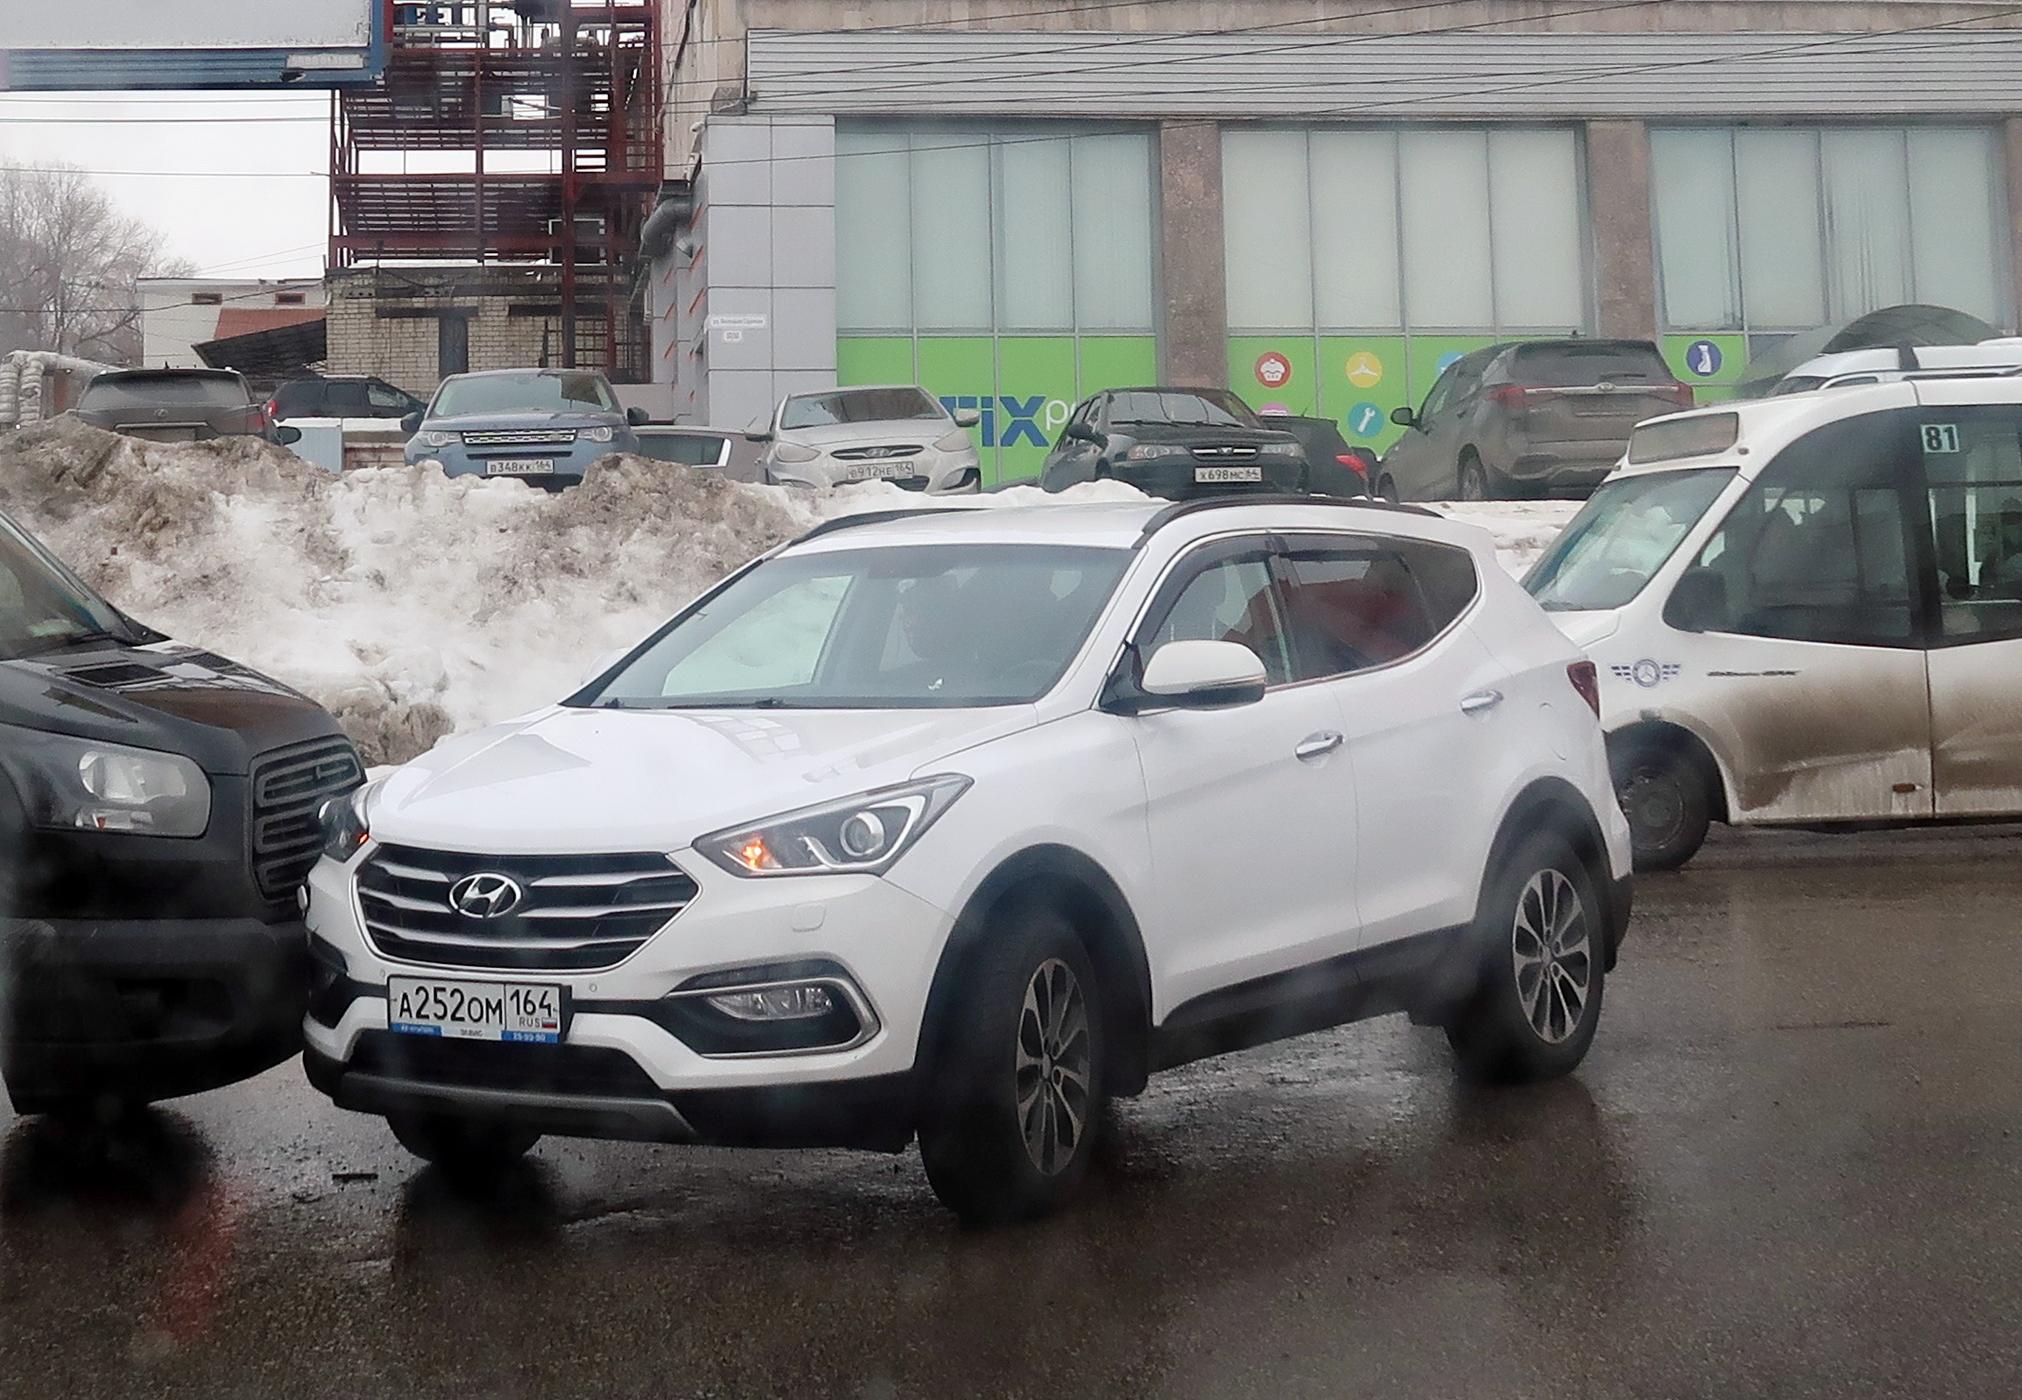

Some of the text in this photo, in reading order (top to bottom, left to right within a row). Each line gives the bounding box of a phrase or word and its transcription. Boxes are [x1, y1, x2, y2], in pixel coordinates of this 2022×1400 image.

[1045, 399, 1078, 431] p
[1925, 426, 1956, 451] 81
[399, 985, 553, 1025] А252ОМ 164
[519, 1018, 541, 1028] RUS
